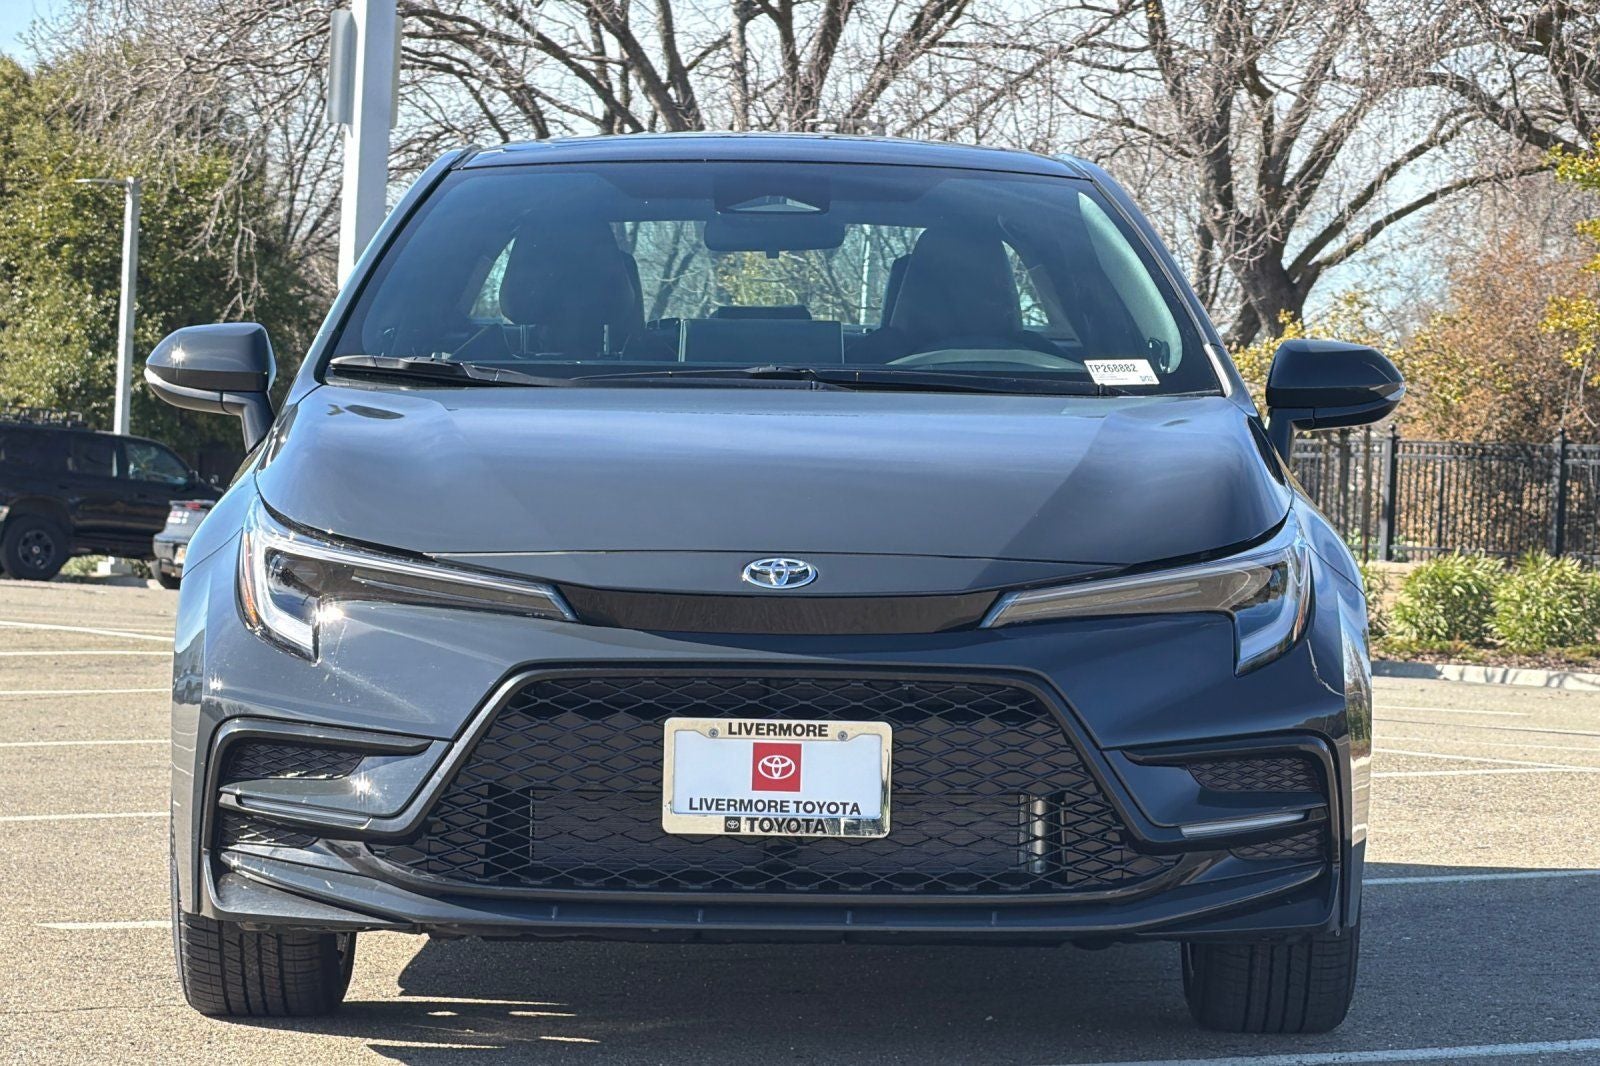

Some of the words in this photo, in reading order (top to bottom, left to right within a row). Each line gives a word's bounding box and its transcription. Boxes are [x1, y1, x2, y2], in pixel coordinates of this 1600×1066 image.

[1087, 364, 1139, 373] TP268882
[728, 722, 829, 737] LIVERMORE
[689, 798, 790, 813] LIVERMORE
[793, 801, 861, 816] TOYOTA
[745, 817, 827, 834] TOYOTA
